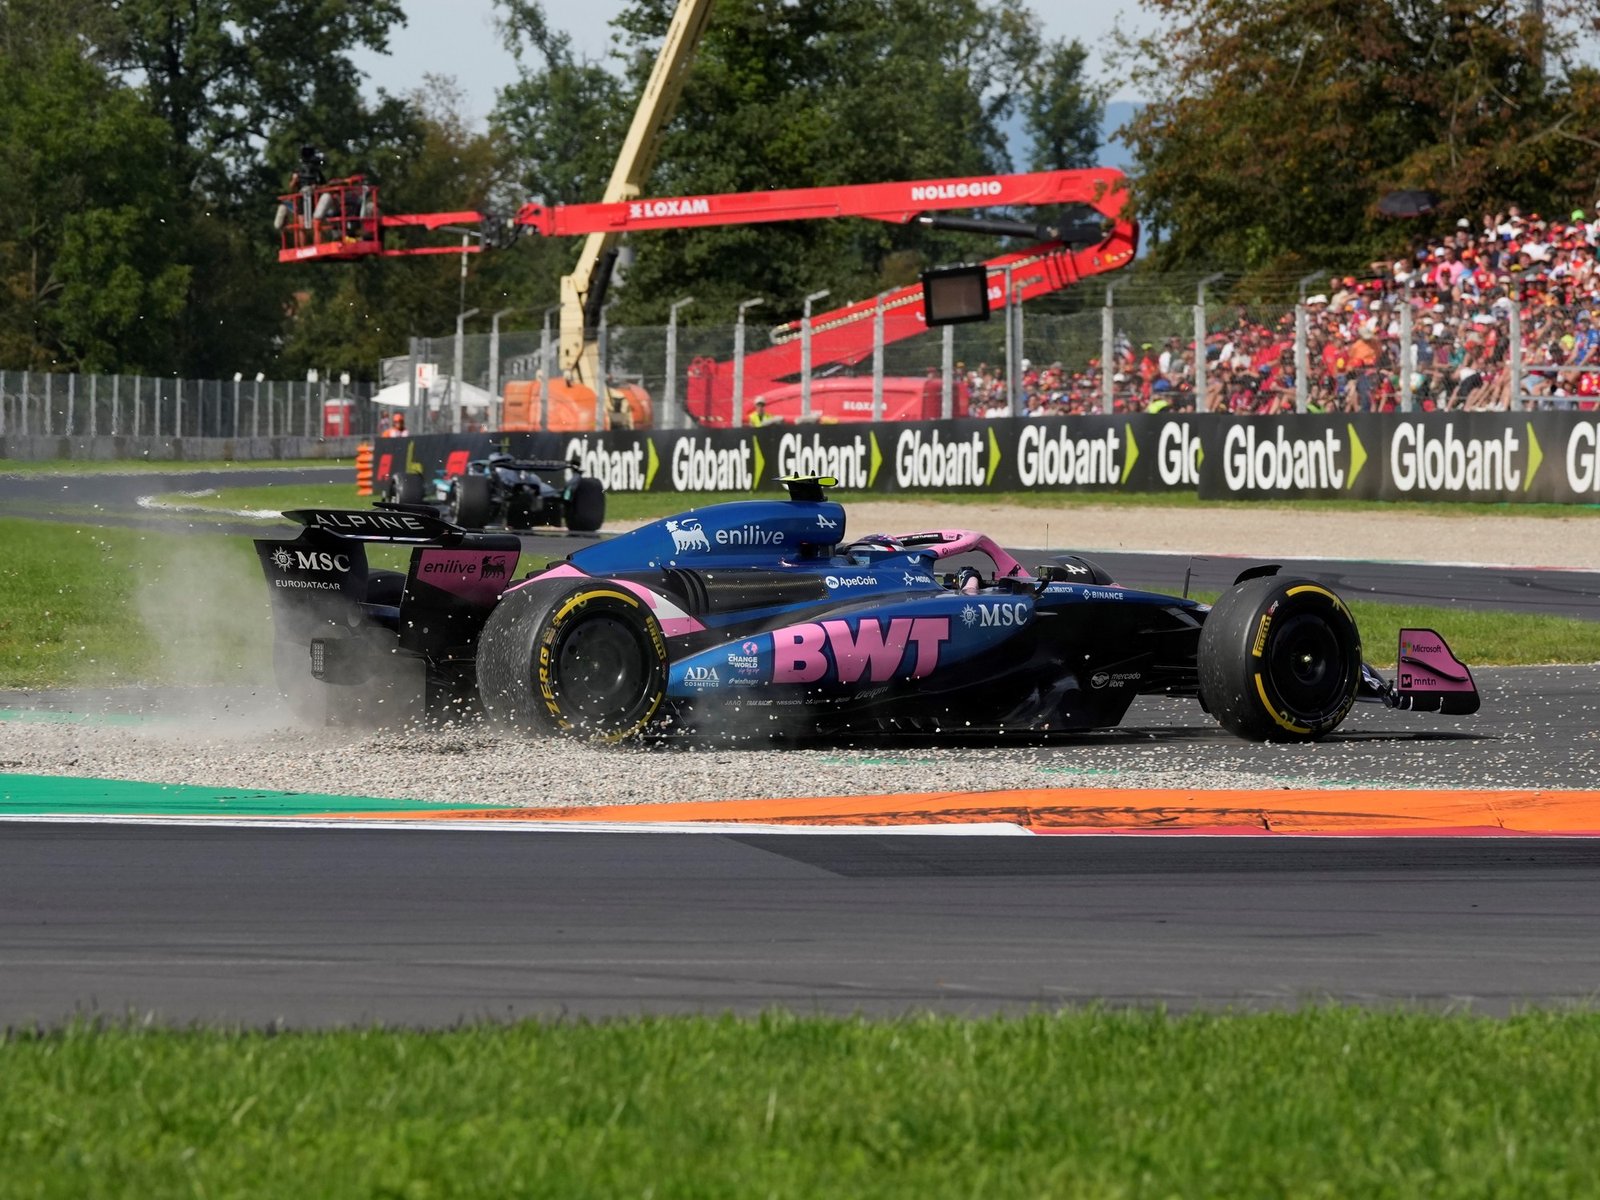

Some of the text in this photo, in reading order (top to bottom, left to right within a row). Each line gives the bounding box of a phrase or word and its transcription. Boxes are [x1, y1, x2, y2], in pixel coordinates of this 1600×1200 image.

[911, 181, 1002, 201] NOLEGGIO
[643, 198, 710, 218] LOXAM
[673, 437, 753, 492] Globant
[778, 432, 868, 490] Globant
[896, 429, 986, 488] Globant
[1017, 425, 1120, 487] Globant
[1223, 424, 1344, 491] Globant
[1391, 421, 1520, 491] Globant
[315, 513, 425, 530] ALPINE
[715, 525, 784, 545] enilive
[295, 551, 351, 572] MSC
[424, 560, 477, 574] enilive
[275, 579, 341, 591] EURODATACAR
[840, 575, 878, 588] ApeCoin
[1092, 591, 1124, 600] BINANCE
[978, 602, 1028, 626] MSC
[772, 617, 949, 684] BWT
[1412, 644, 1442, 653] Microsoft
[539, 646, 561, 714] ZERO
[684, 666, 720, 680] ADA
[1111, 672, 1141, 680] mercado
[1414, 678, 1437, 686] mntn
[1109, 680, 1125, 688] libre
